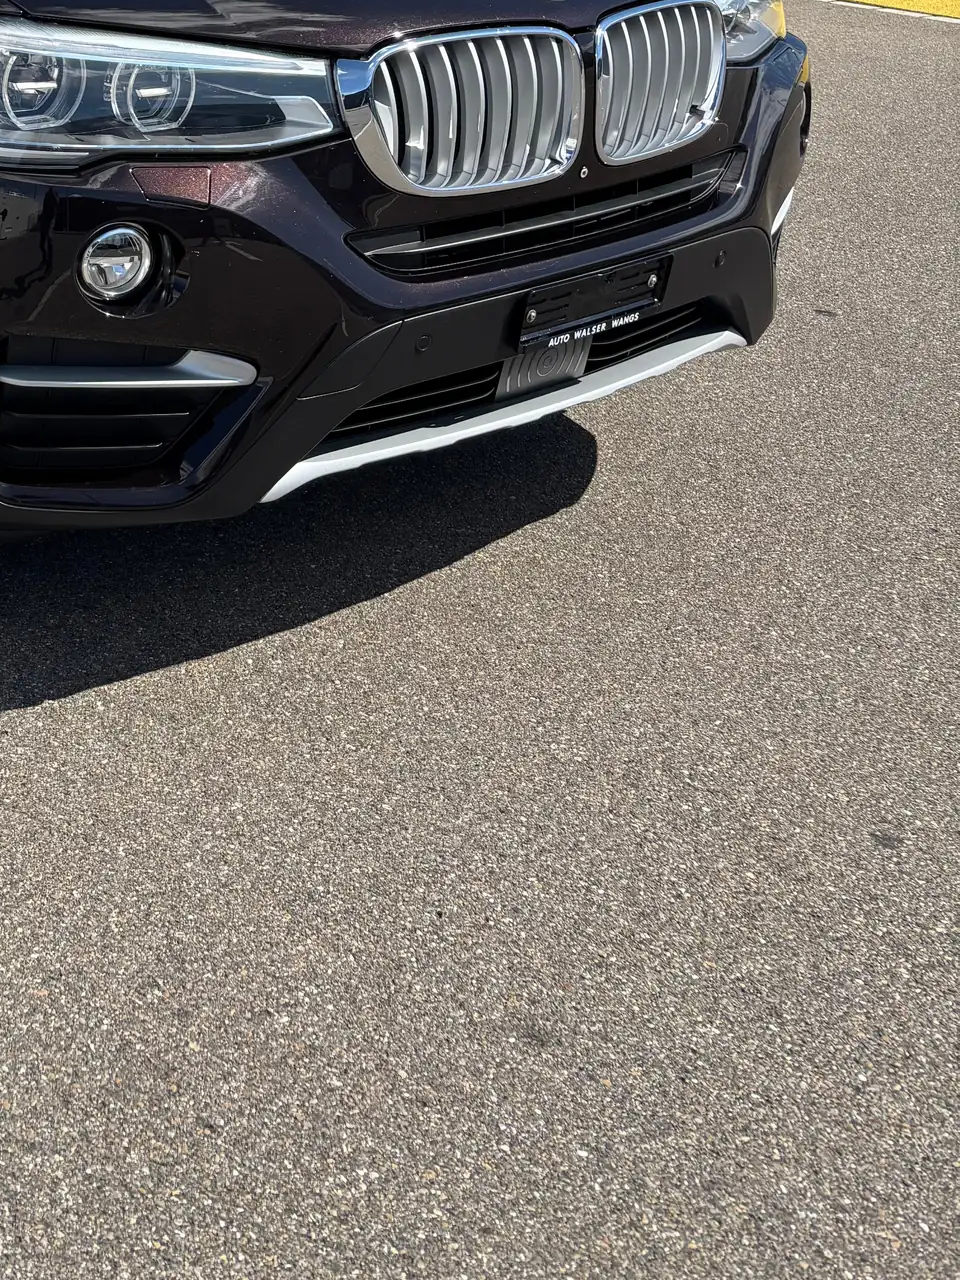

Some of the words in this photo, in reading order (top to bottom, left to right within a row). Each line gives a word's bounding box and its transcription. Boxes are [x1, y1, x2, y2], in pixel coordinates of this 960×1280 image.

[548, 333, 570, 347] AUTO
[574, 322, 607, 339] WALSER
[611, 312, 640, 328] WANGS
